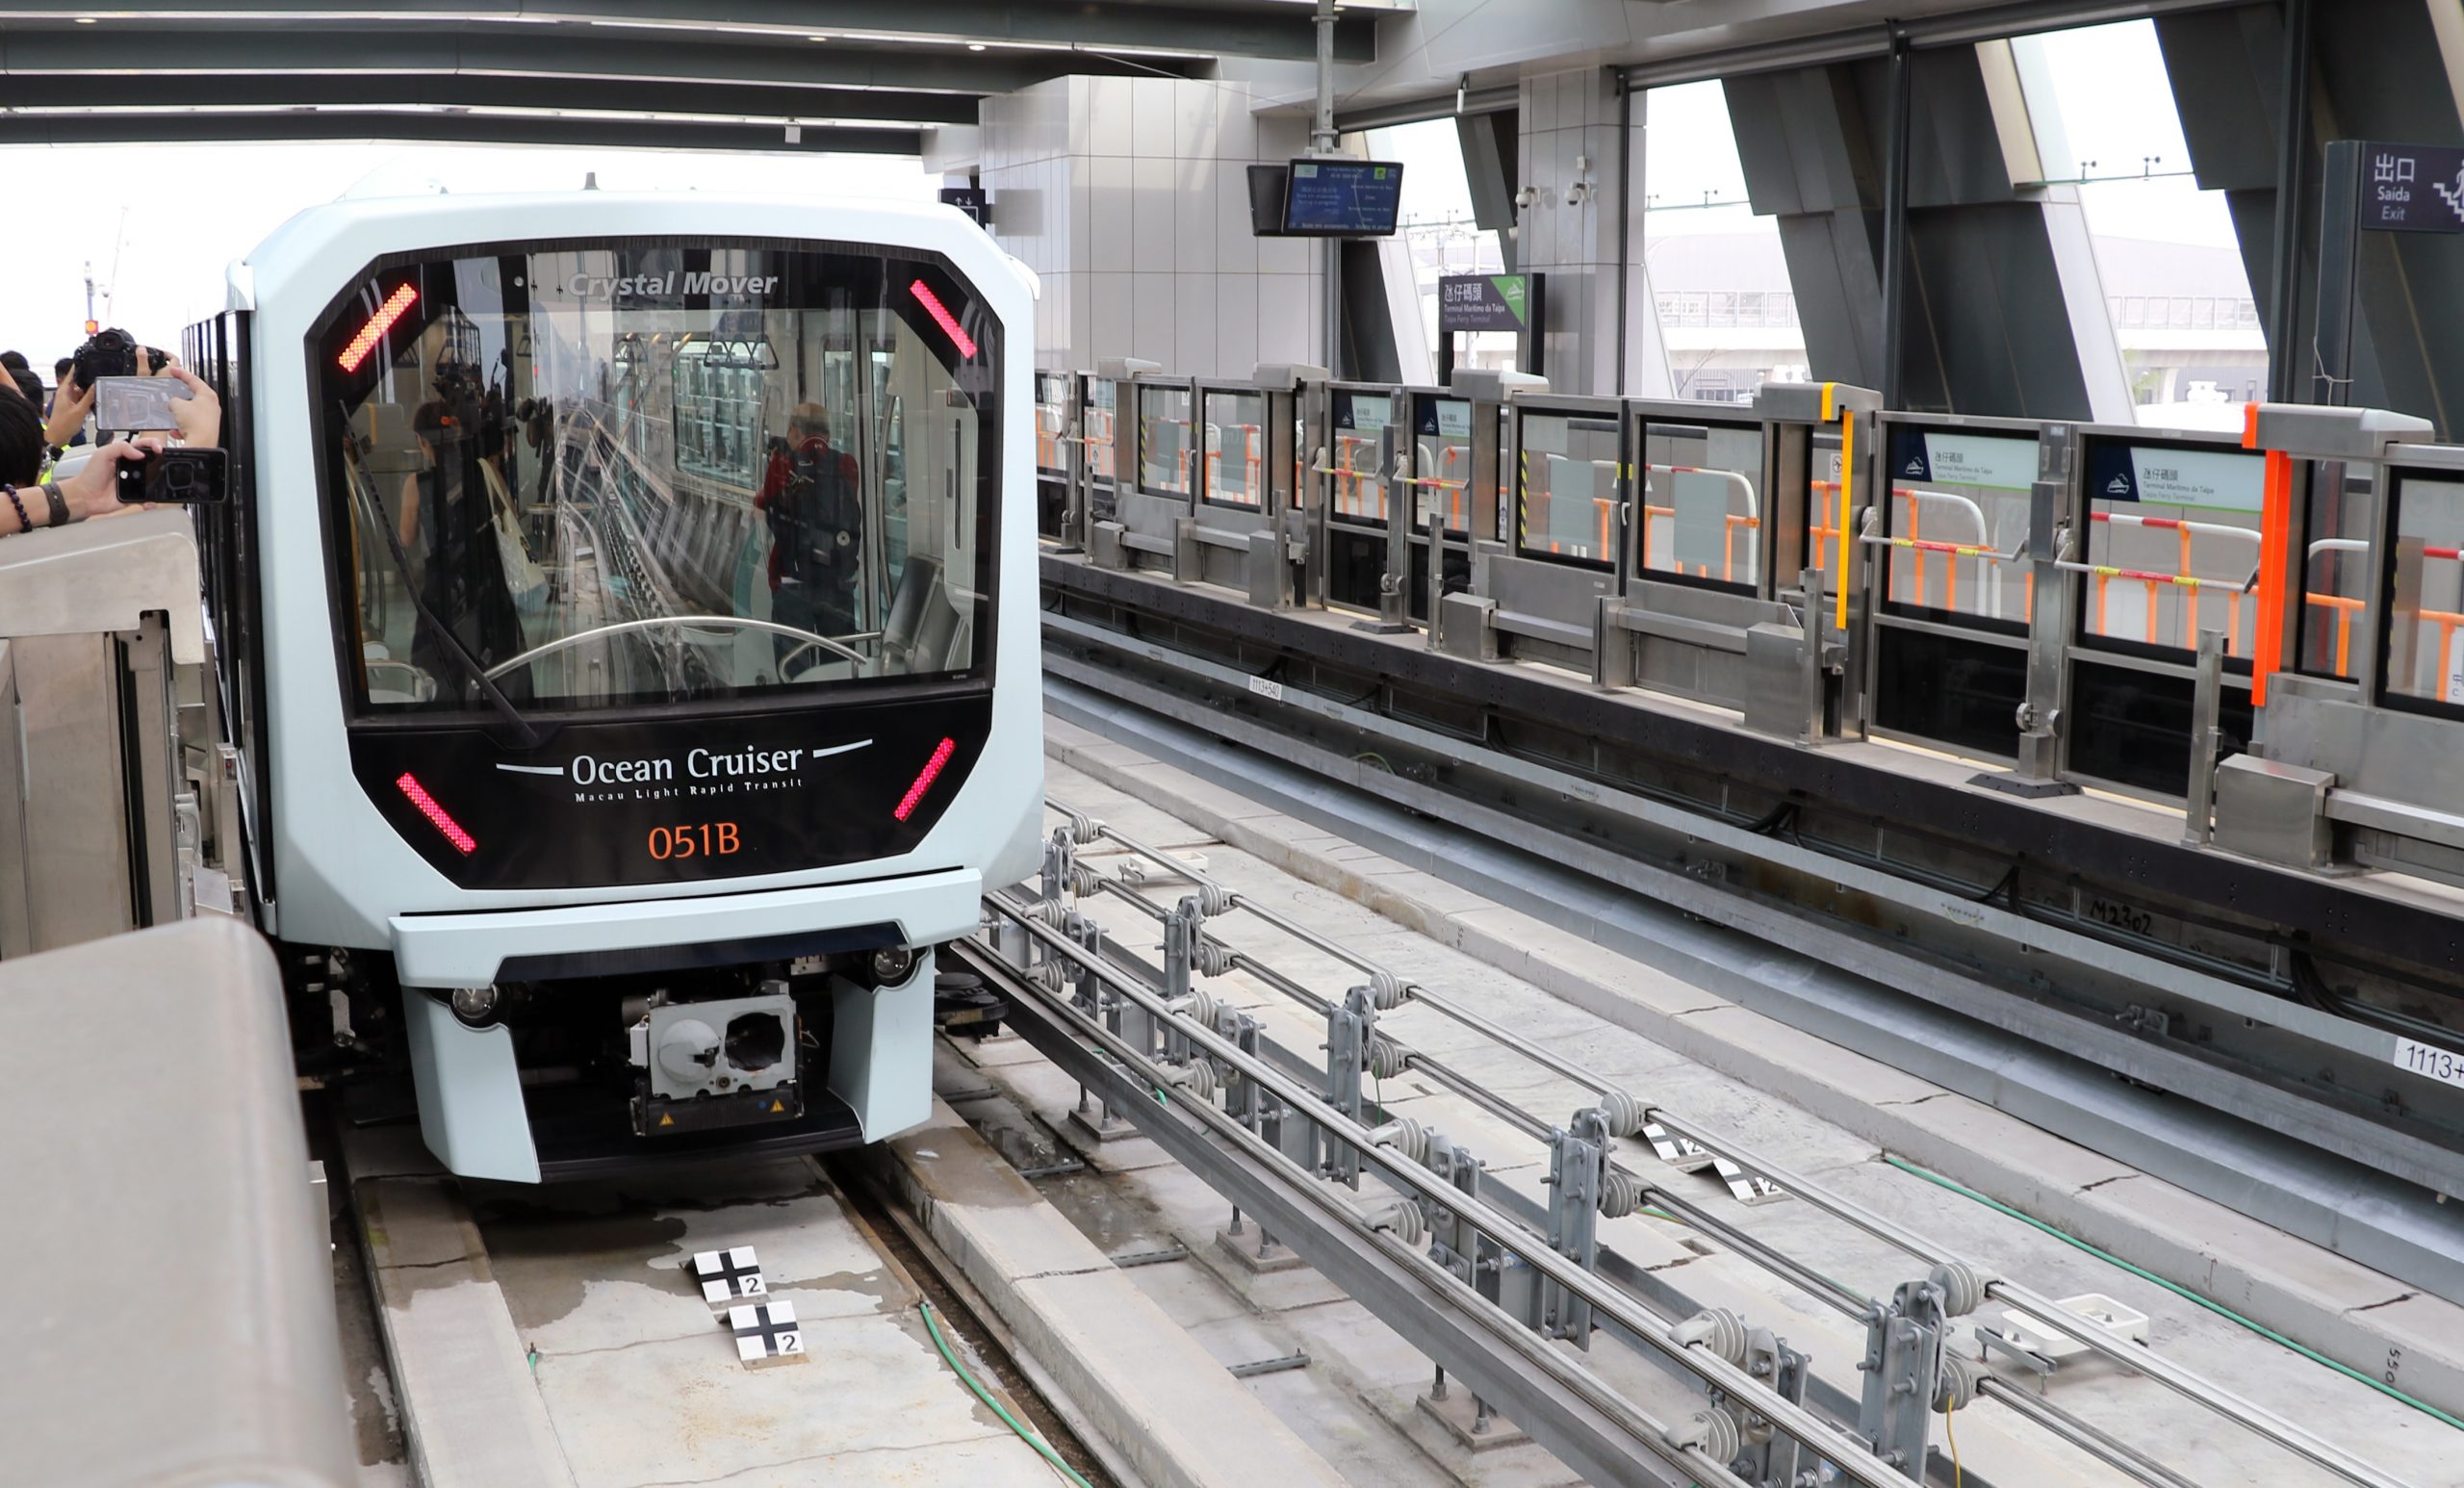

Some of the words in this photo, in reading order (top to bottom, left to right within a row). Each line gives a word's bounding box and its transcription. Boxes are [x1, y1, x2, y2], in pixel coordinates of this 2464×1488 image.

[2374, 153, 2415, 182] 出口
[2377, 185, 2410, 202] Saída
[2381, 205, 2405, 220] Exit
[567, 270, 674, 302] Crystal
[682, 271, 779, 295] Mover
[1252, 678, 1279, 698] 1113+540
[572, 755, 673, 785] Ocean
[687, 744, 803, 779] Cruiser
[575, 792, 625, 803] Macau
[635, 787, 680, 801] Light
[690, 782, 734, 797] Rapid
[744, 778, 803, 792] Transit
[648, 821, 740, 860] 051B
[2407, 1044, 2464, 1079] 1113+
[745, 1277, 760, 1294] 2
[783, 1334, 798, 1352] 2
